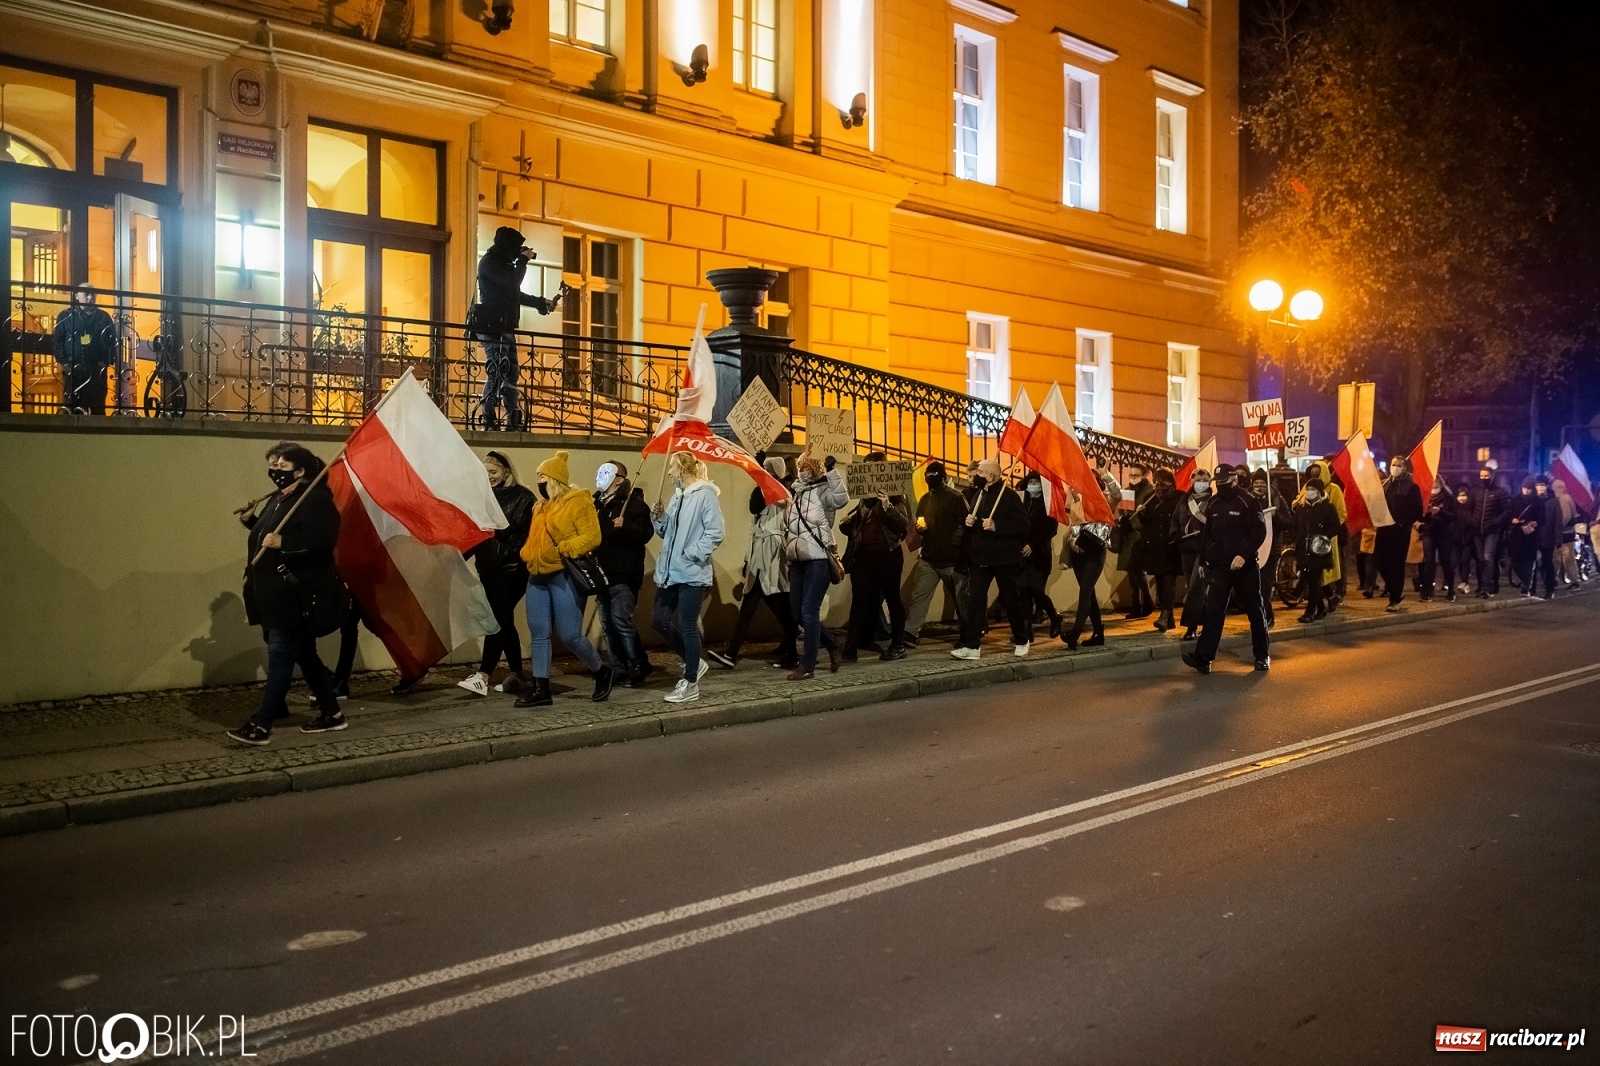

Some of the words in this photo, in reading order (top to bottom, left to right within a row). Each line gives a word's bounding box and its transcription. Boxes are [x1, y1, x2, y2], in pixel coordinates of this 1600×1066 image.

[237, 146, 267, 157] Raciborzu
[751, 380, 777, 414] WITAMY
[751, 399, 775, 431] PIEKLE
[1245, 402, 1282, 419] WOLNA
[1287, 419, 1305, 434] PIS
[1249, 431, 1285, 448] POLKA
[1286, 435, 1308, 449] OFF!
[847, 464, 872, 475] JAREK
[875, 463, 886, 472] TO
[888, 462, 912, 472] TWOJA
[847, 475, 866, 484] WINA
[870, 473, 893, 483] TWOJA
[847, 484, 877, 495] WIELKA
